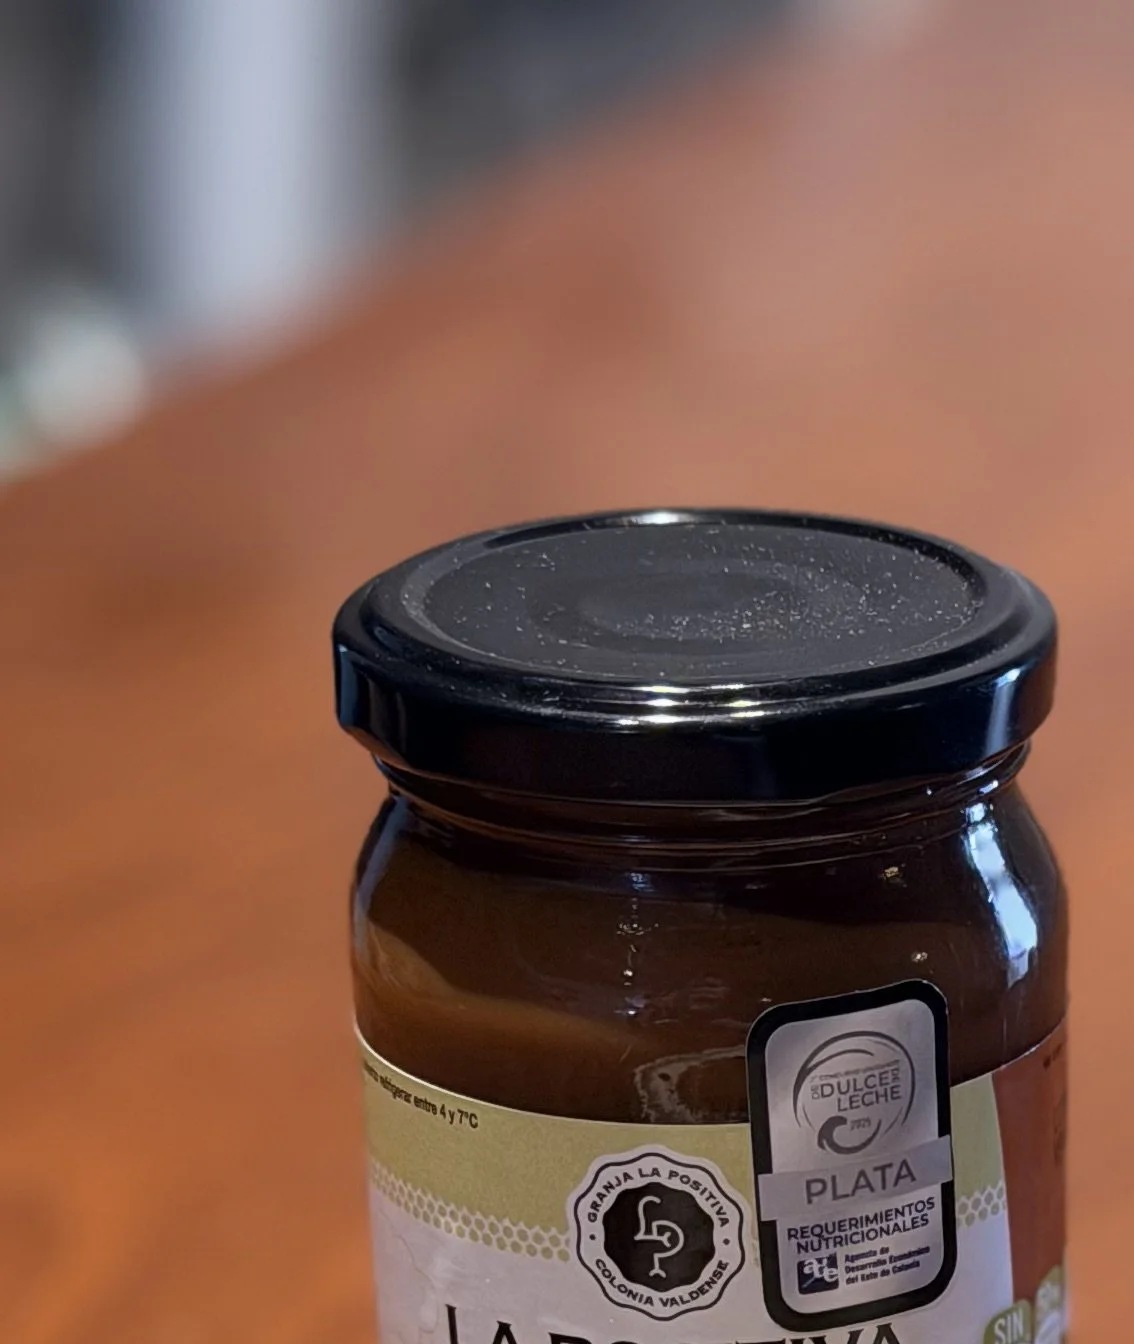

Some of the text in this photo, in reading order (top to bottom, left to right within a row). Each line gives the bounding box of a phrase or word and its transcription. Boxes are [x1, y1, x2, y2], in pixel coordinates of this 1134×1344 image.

[820, 1072, 890, 1100] DULCE
[837, 1085, 902, 1112] LECHE
[440, 1104, 447, 1119] 4
[448, 1109, 455, 1125] y
[587, 1168, 730, 1228] GRANJA LA POSITIVA
[805, 1158, 917, 1205] PLATA
[787, 1196, 936, 1241] REQUERIMIENTOS
[796, 1213, 929, 1255] NUTRICIONALES
[595, 1258, 730, 1308] COLONIA VALDENSE
